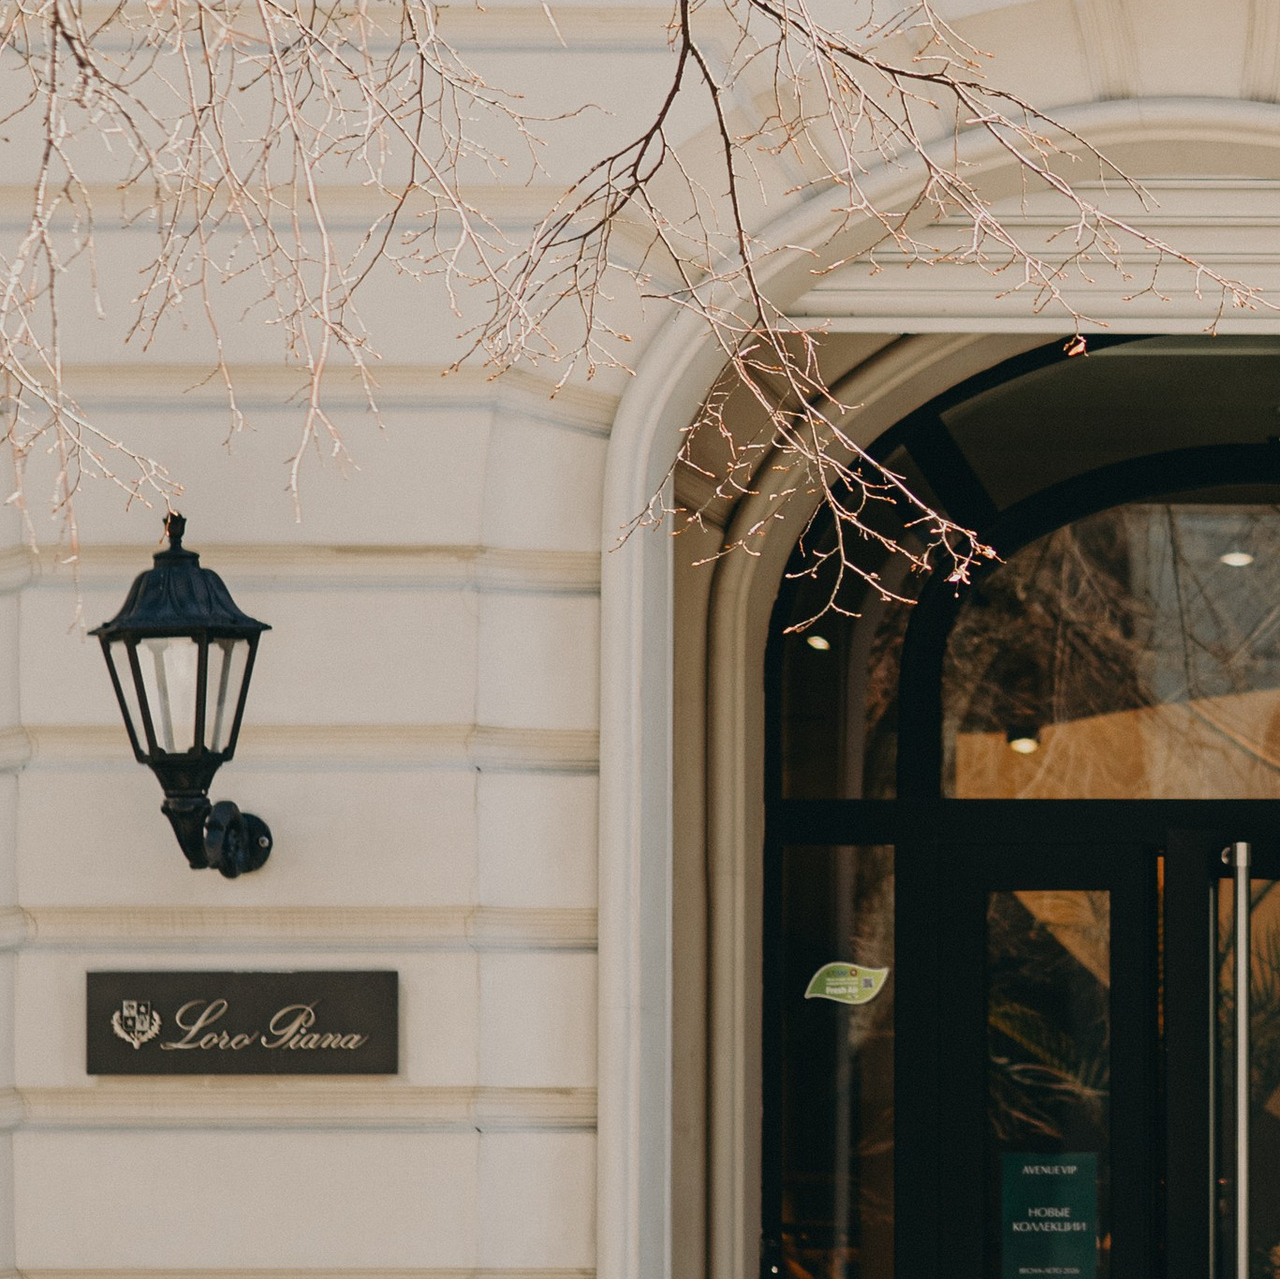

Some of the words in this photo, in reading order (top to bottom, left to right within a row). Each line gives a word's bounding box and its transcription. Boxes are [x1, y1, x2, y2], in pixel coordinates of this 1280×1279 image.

[159, 998, 259, 1050] Loro
[261, 999, 369, 1050] Piana
[1028, 1207, 1071, 1218] НОВЫЕ
[1012, 1221, 1087, 1232] КОЛЛЕКЦИИ
